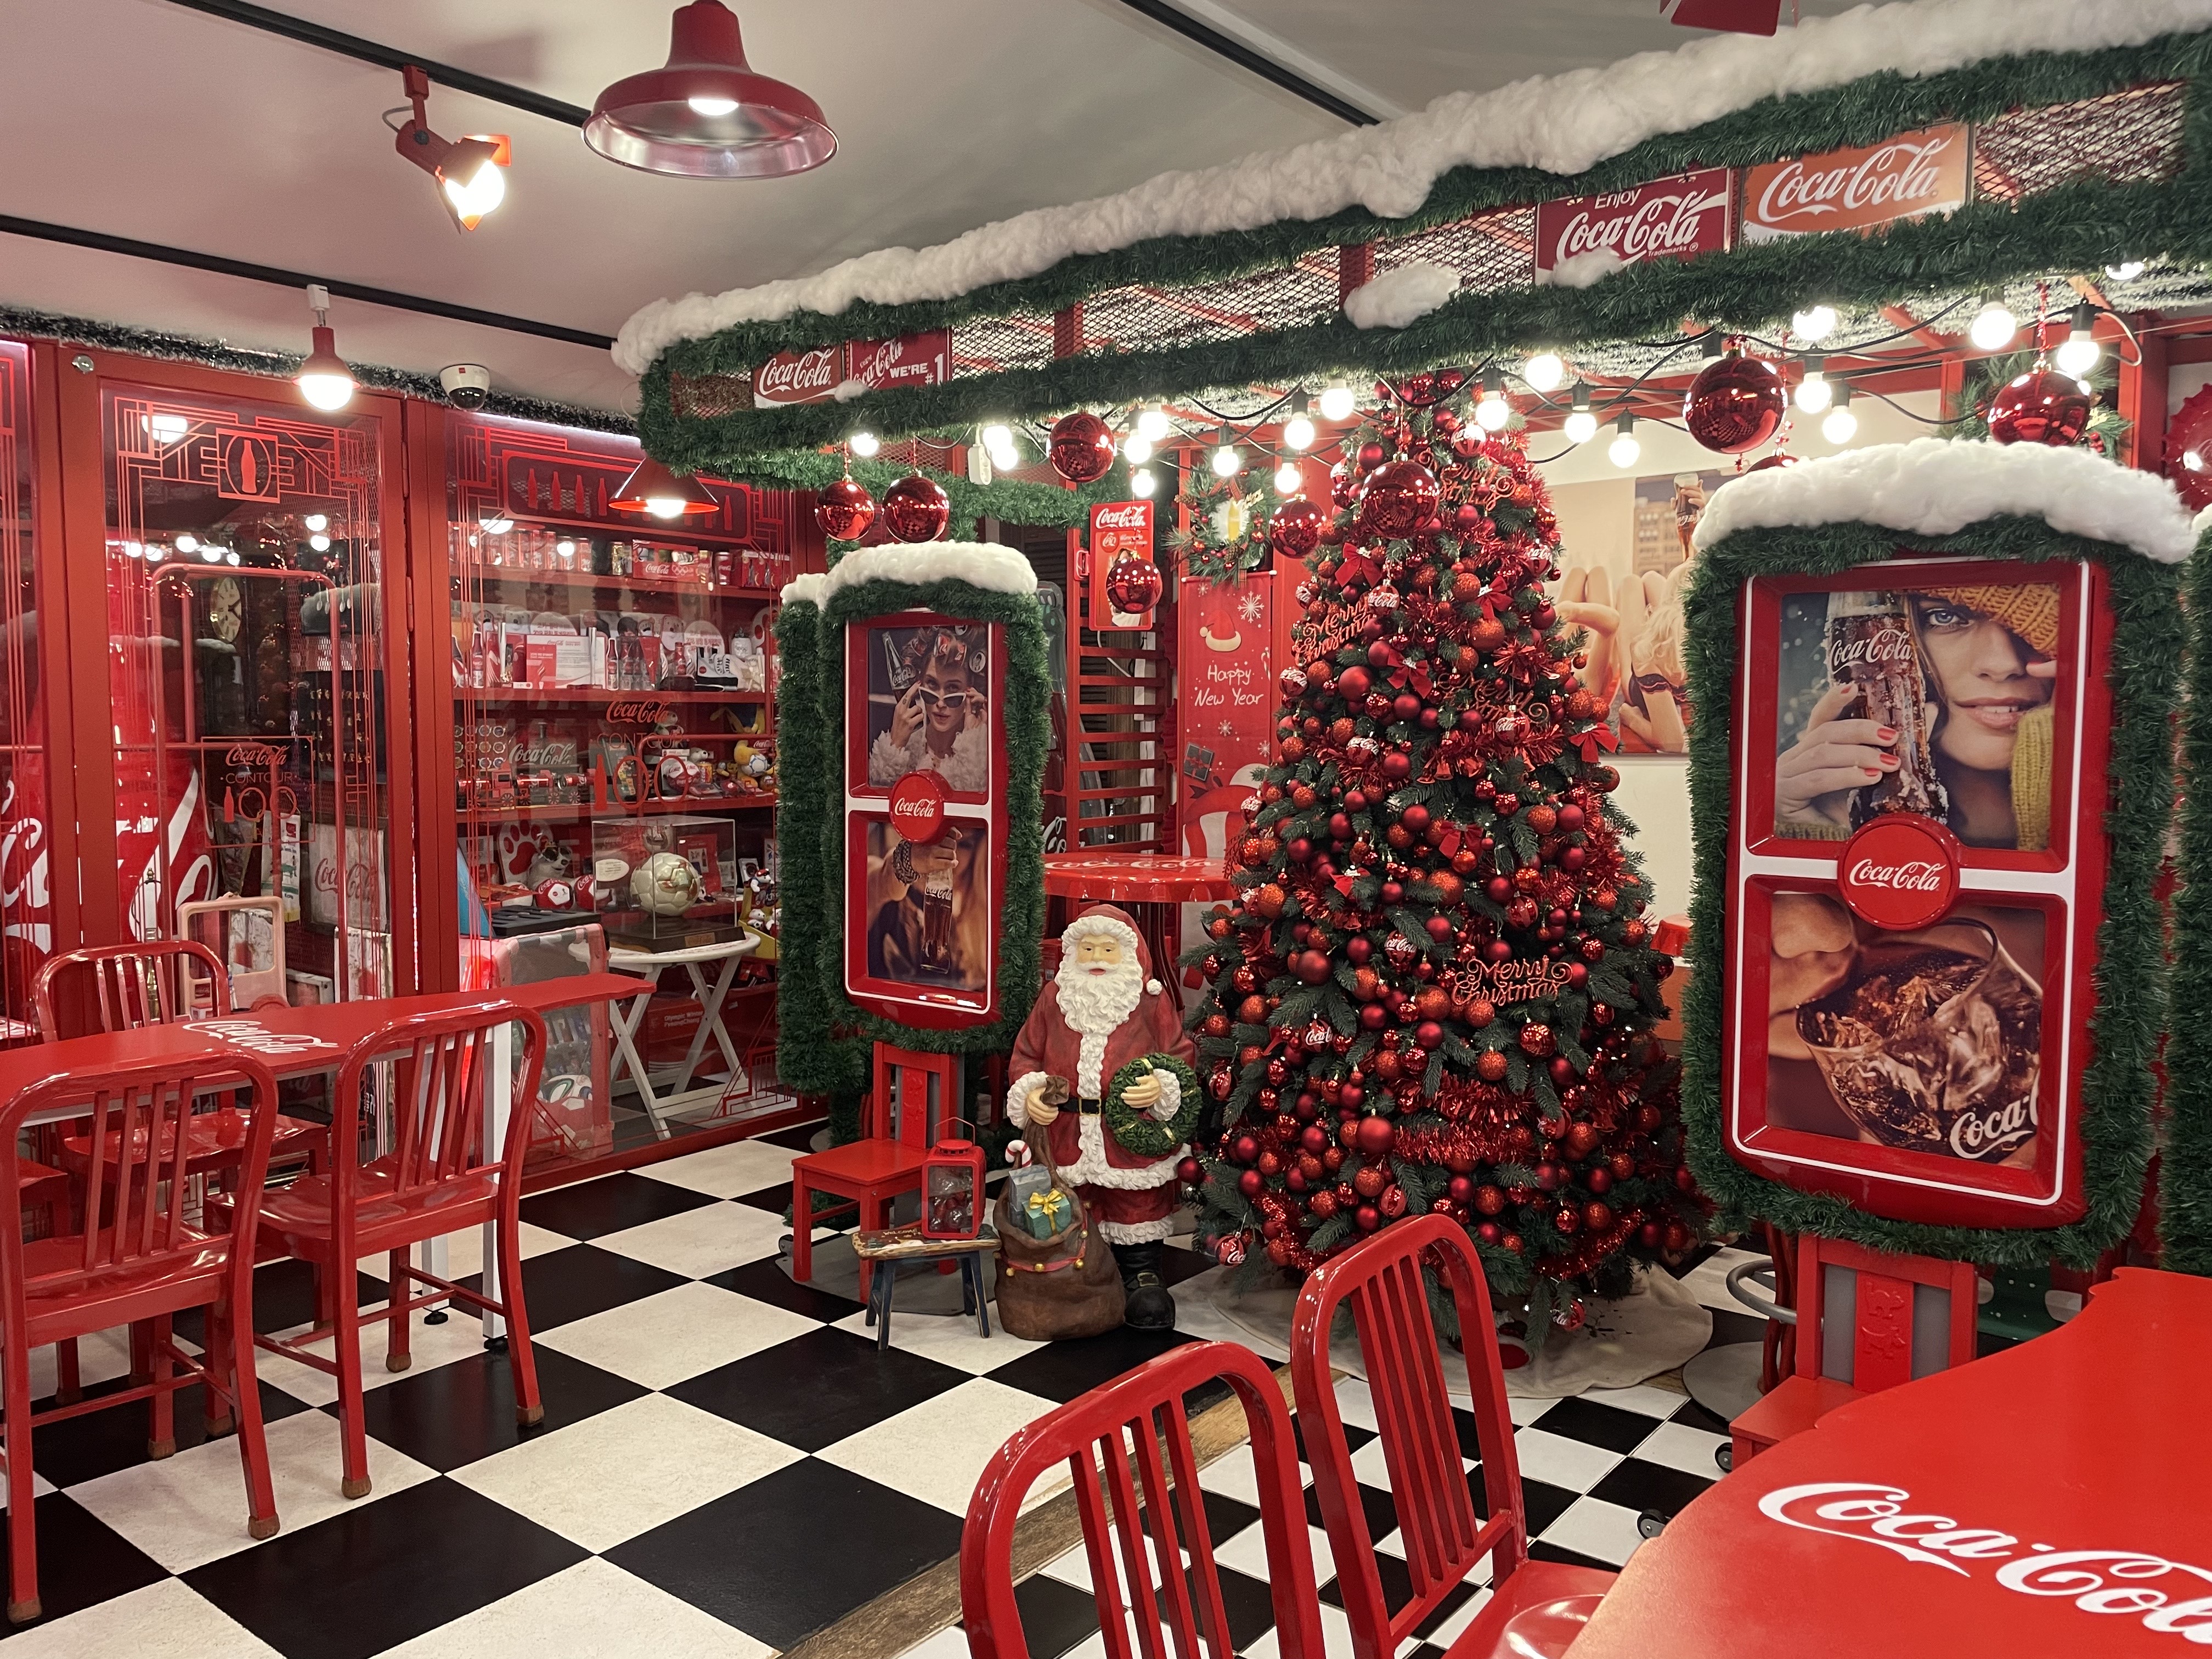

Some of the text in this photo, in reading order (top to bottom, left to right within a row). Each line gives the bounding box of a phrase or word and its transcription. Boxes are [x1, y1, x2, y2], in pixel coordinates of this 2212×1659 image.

[1758, 136, 1954, 223] Coca-Cola
[1594, 187, 1642, 211] Enjoy
[1556, 189, 1708, 266] Coca-Cola
[1647, 243, 1688, 258] Trademarks
[759, 347, 836, 395] Coca-Cola
[889, 362, 928, 379] WE'RE
[1096, 506, 1147, 529] Coca-Cola
[1830, 629, 1912, 674] Coca-Cola
[1207, 664, 1251, 685] Happy
[1194, 688, 1264, 707] New Year
[606, 699, 670, 724] Coca-Cola
[225, 744, 291, 766] Coca-Cola
[894, 797, 937, 818] Coca-Cola
[1849, 859, 1946, 891] Coca-Cola
[1467, 955, 1549, 980] Merry
[1452, 972, 1562, 1006] Christmas
[183, 1021, 339, 1053] Coca-Cola
